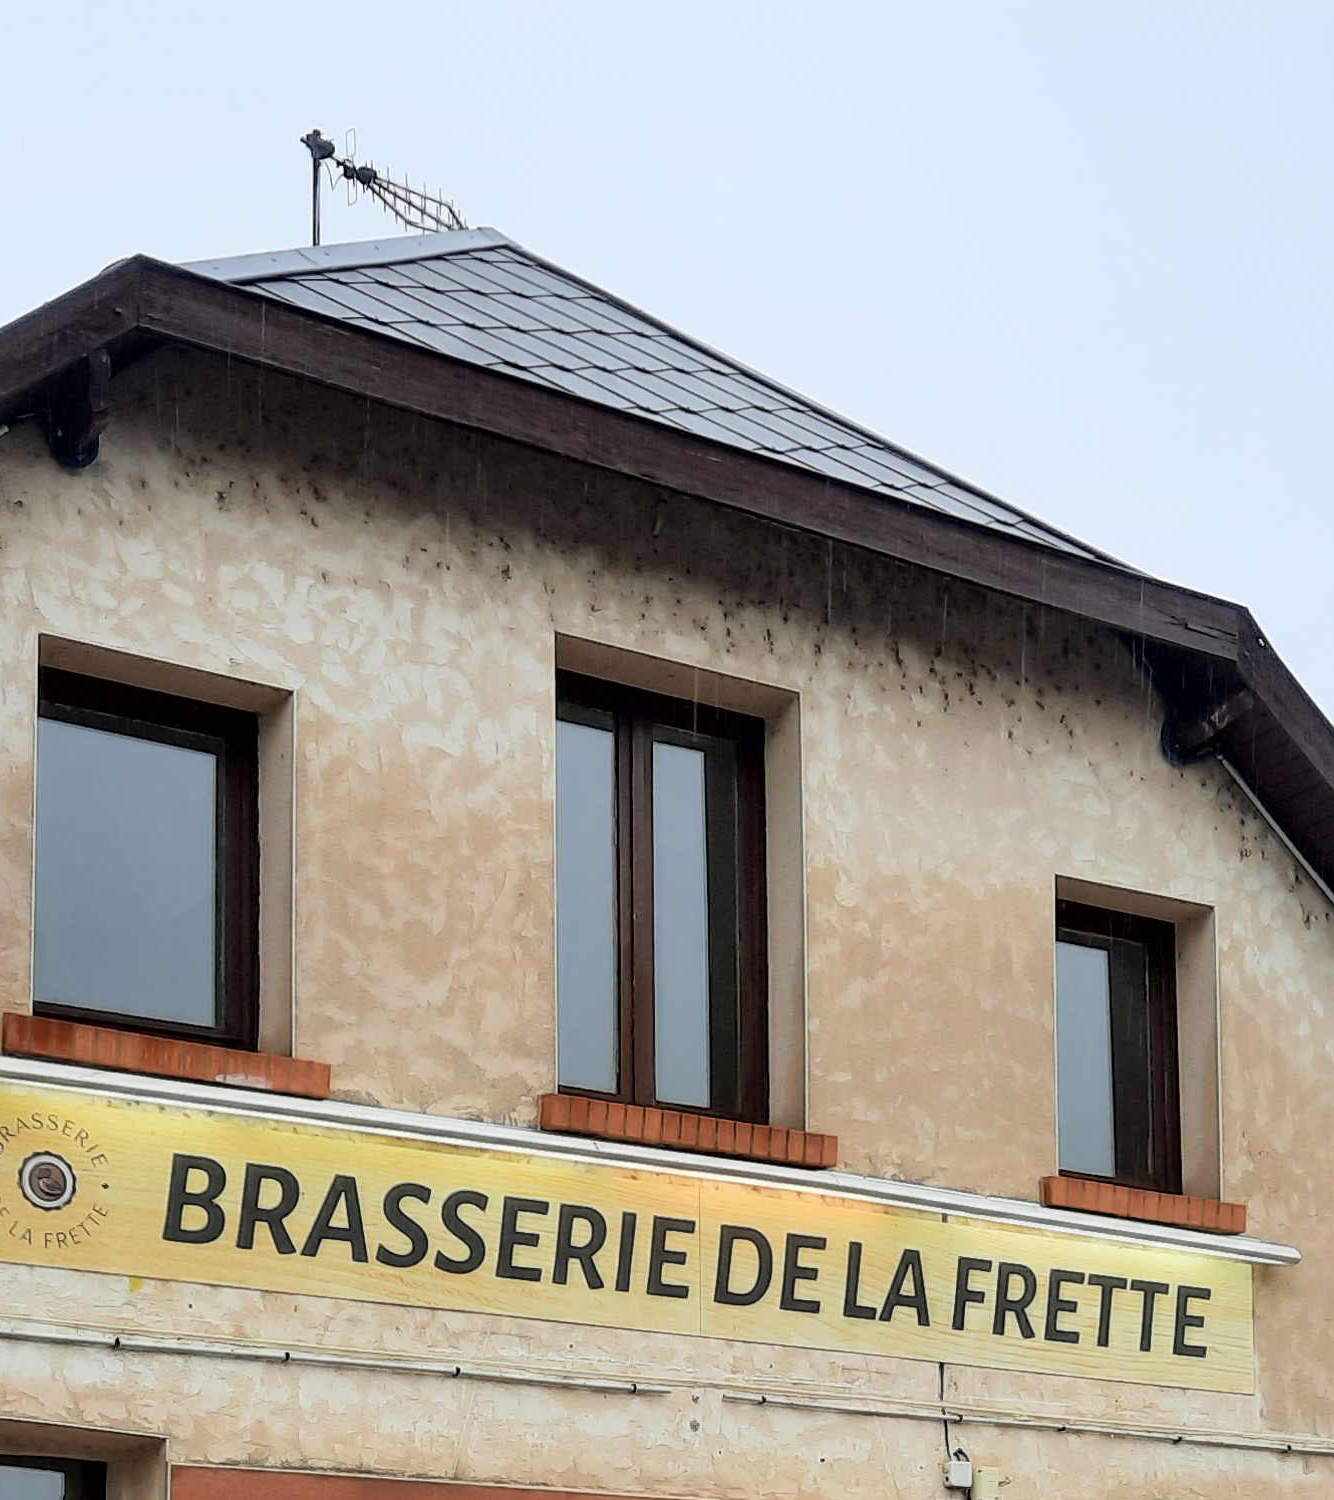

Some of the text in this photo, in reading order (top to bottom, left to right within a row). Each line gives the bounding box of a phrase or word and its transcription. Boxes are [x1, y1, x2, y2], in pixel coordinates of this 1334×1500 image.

[9, 1221, 32, 1246] LA
[44, 1204, 109, 1249] FRETTE
[161, 1153, 1213, 1359] BRASSERIE DE LA FRETTE
